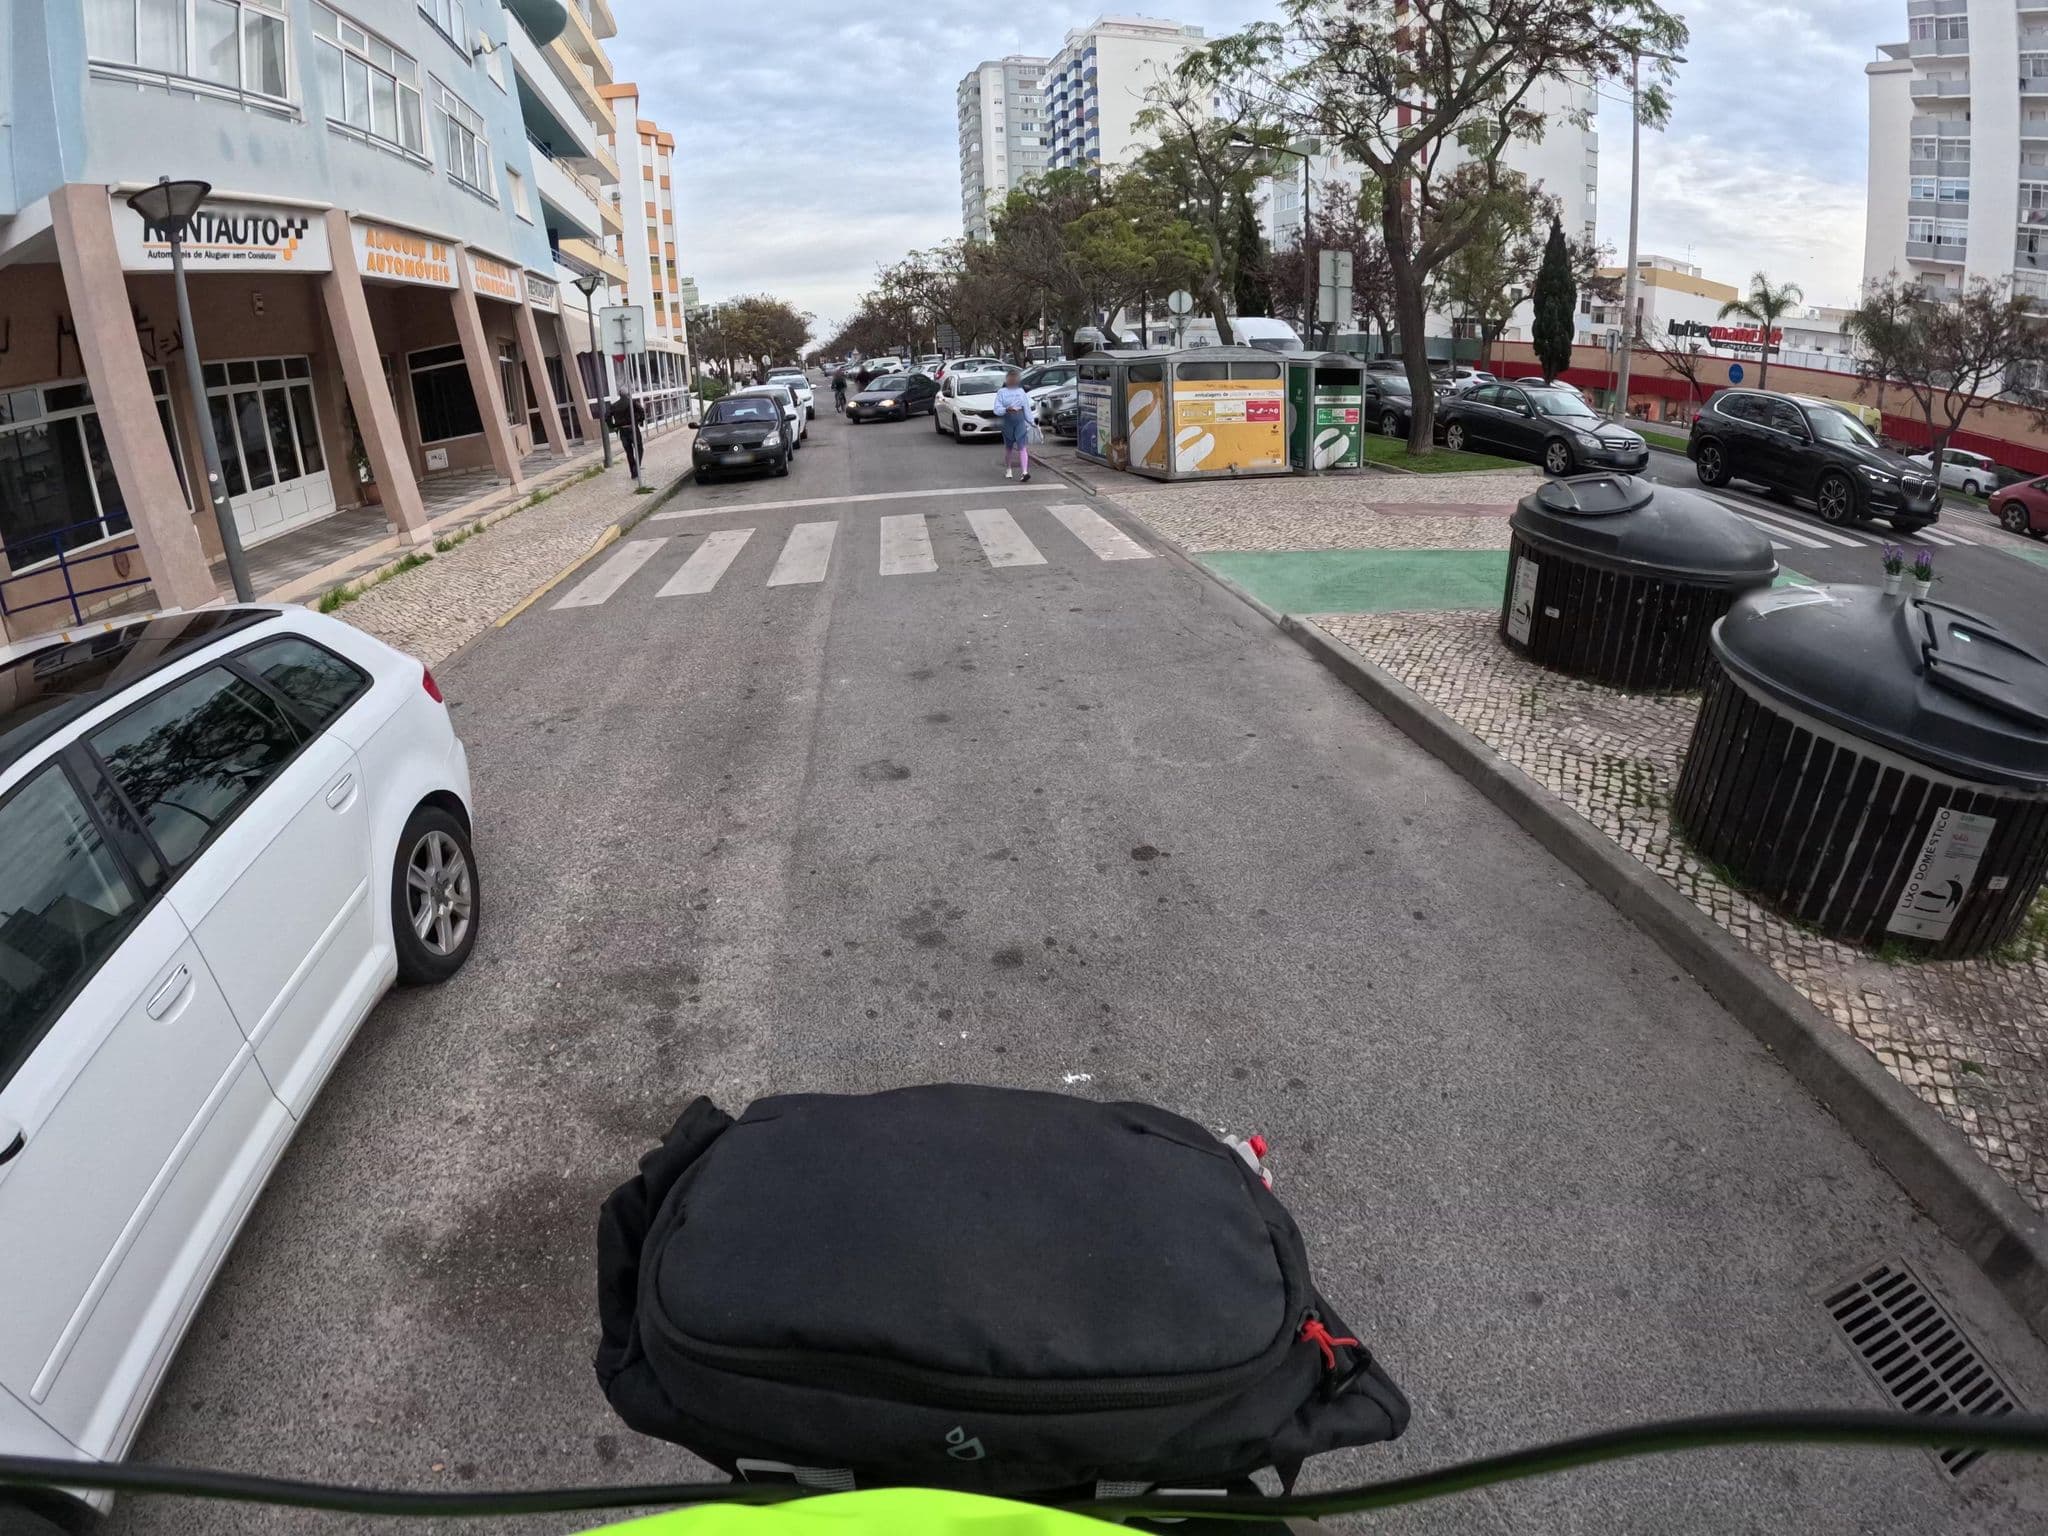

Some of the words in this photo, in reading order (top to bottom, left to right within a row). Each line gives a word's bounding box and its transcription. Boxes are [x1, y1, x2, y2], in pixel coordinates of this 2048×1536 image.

[144, 210, 280, 246] RNTAUTO
[147, 250, 191, 259] Automeis
[366, 251, 451, 283] AUTOMÓVEIS
[432, 242, 447, 262] DE
[1901, 882, 1920, 909] LIXO
[1914, 810, 1951, 881] DOMÉSTICO
